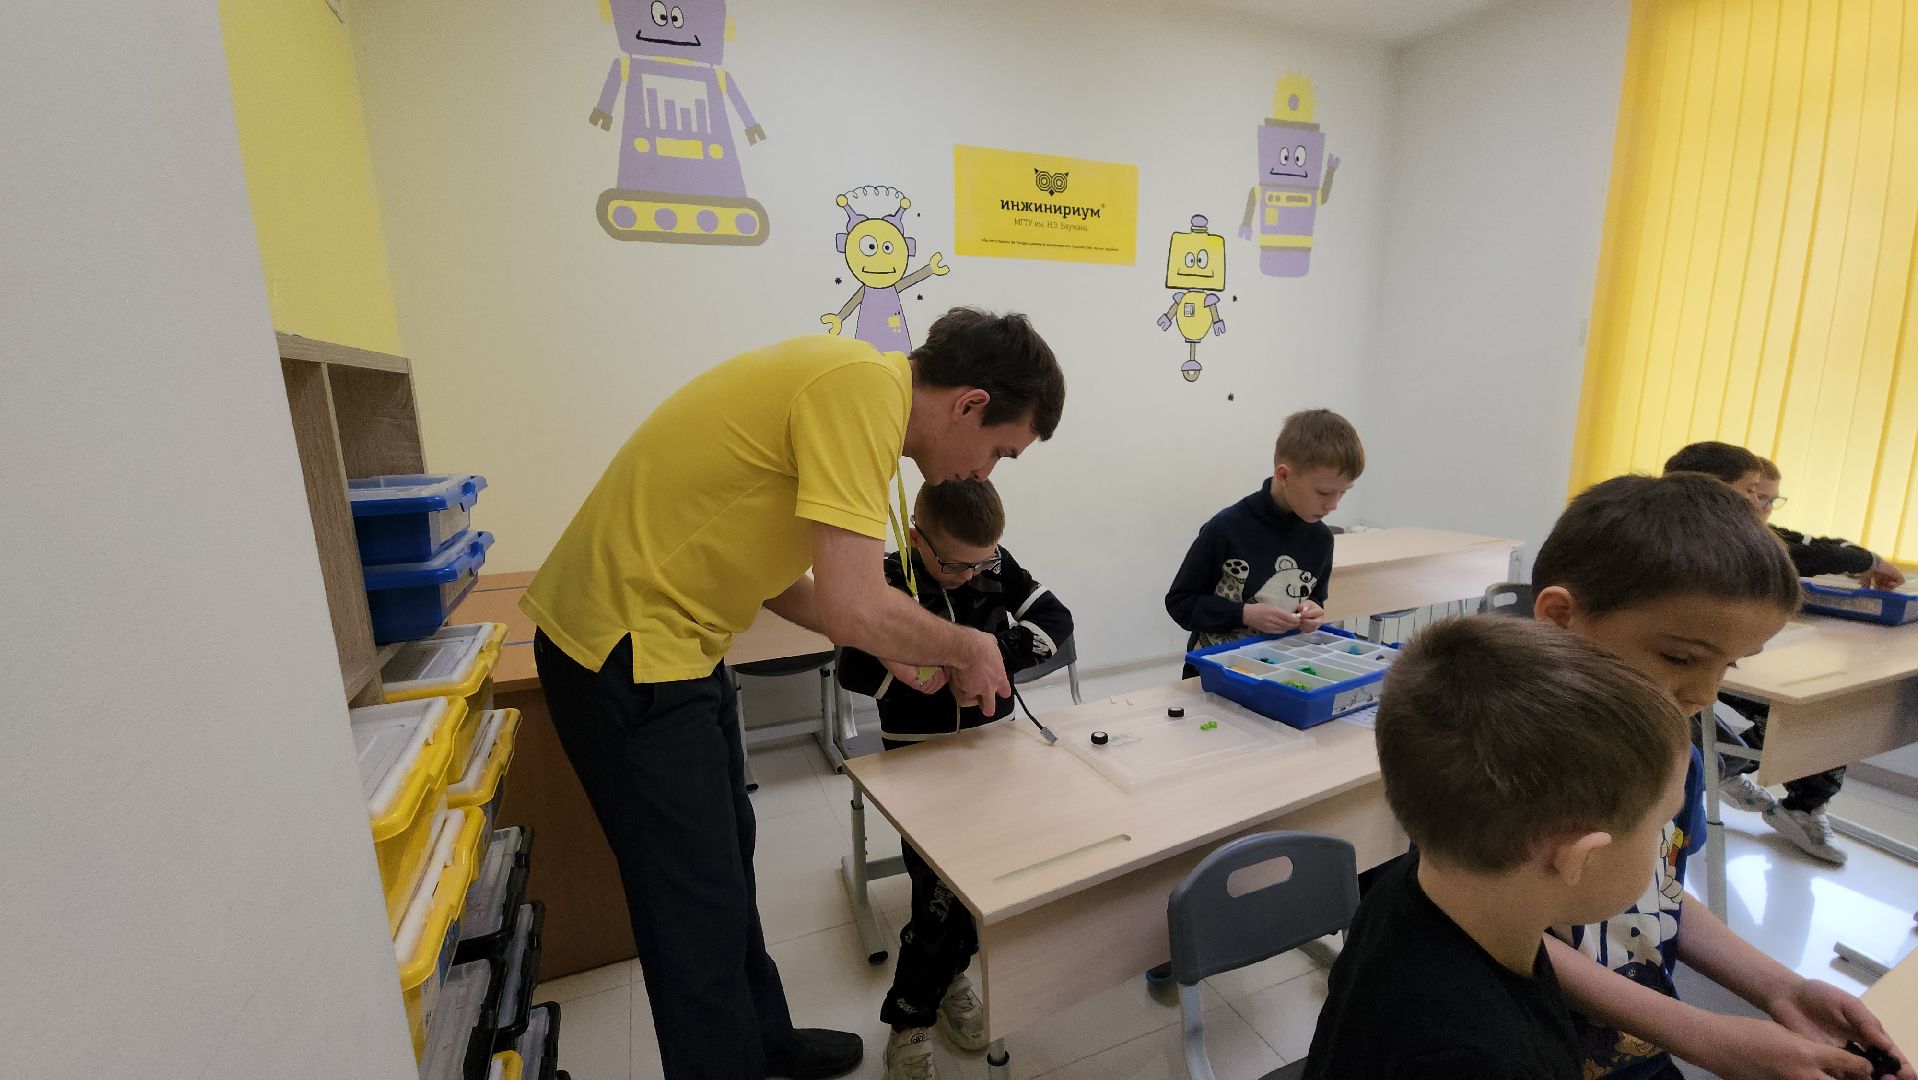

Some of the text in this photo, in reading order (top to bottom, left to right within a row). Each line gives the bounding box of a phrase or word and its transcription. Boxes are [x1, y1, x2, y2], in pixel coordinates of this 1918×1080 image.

[1000, 199, 1101, 221] инжинириум
[1014, 218, 1033, 227] МГТУ
[1061, 221, 1088, 232] Баумана
